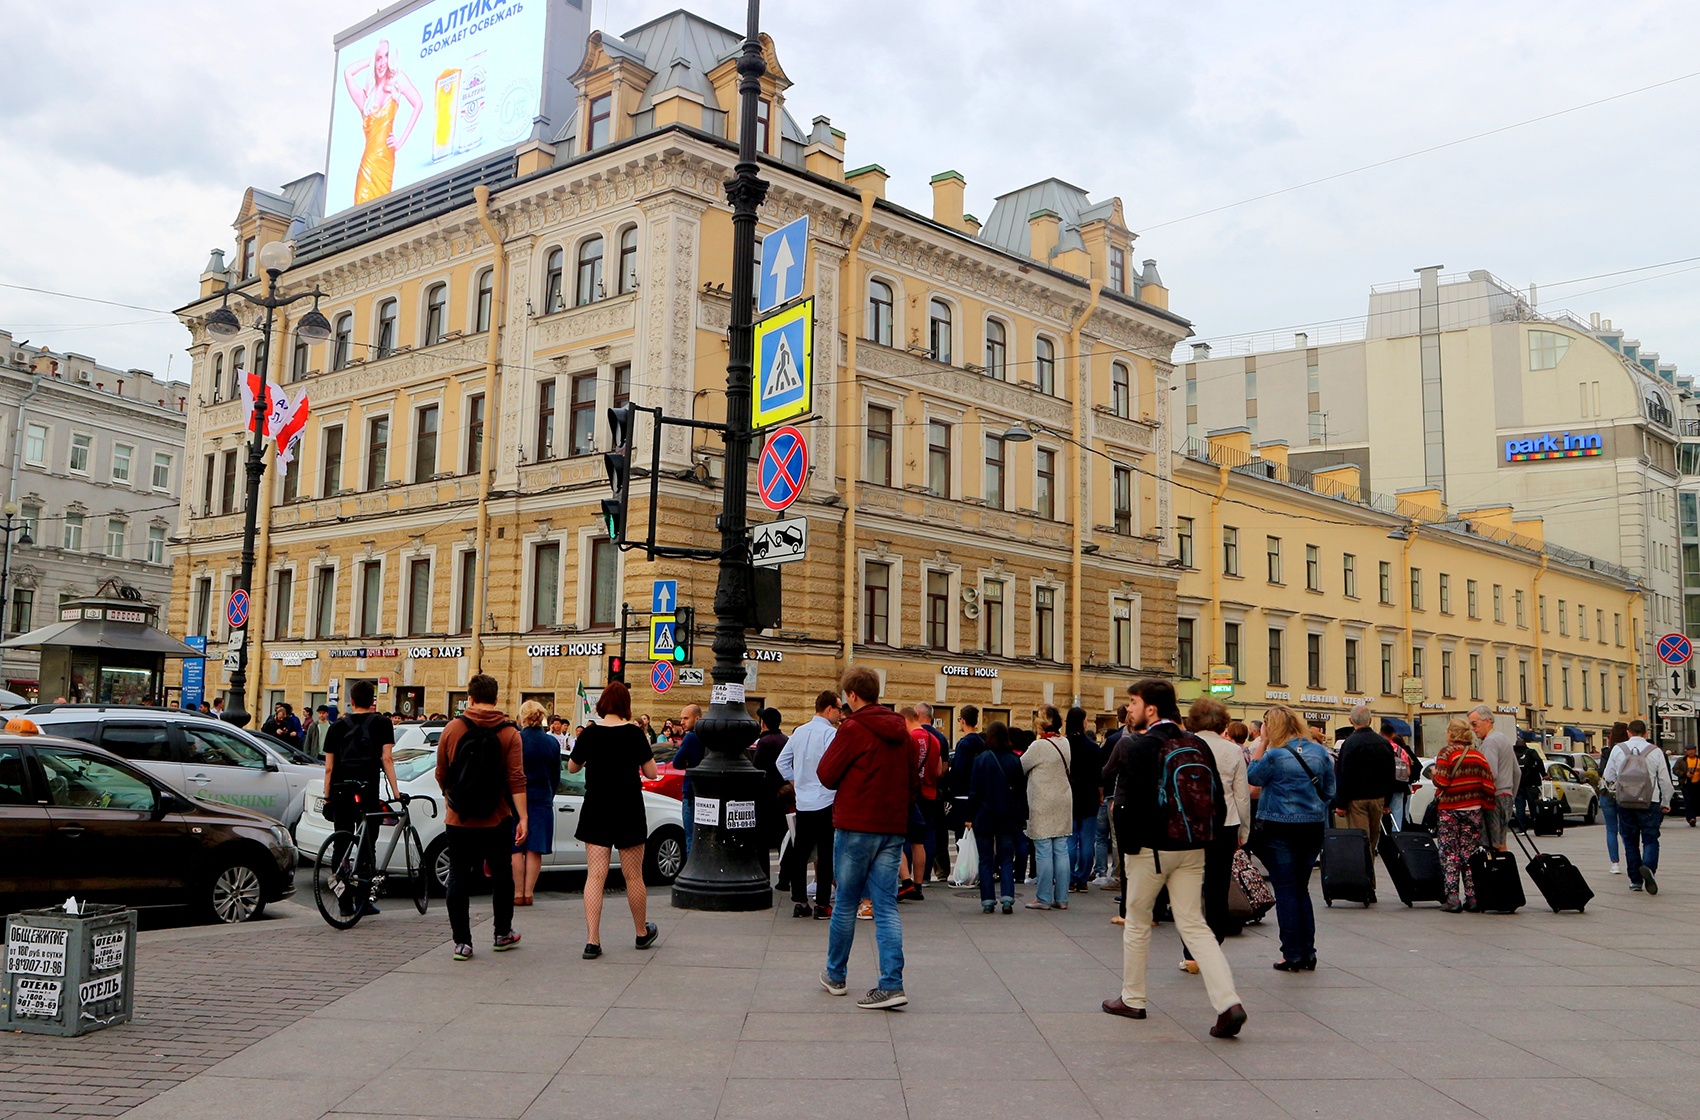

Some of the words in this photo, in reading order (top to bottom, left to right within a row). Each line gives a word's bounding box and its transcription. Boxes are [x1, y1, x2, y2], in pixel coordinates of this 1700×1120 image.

[420, 27, 468, 59] ОБОЖАЕТ
[469, 2, 524, 35] ОСВЕЖАТЬ
[1505, 433, 1559, 462] park
[1563, 431, 1602, 450] inn
[408, 647, 431, 658] КОФЕ
[438, 647, 463, 658] ХАУЗ
[527, 645, 560, 657] COFFEE
[569, 643, 603, 655] HOUSE
[756, 650, 783, 662] ХАУЗ
[943, 665, 969, 675] COFFEE
[974, 667, 999, 678] HOUSE
[1266, 691, 1291, 700] HOTEL
[197, 788, 277, 808] SUNSHINE
[11, 927, 66, 945] ОБЩЕЖИТИЕ
[96, 935, 123, 946] ОТЕЛЬ
[20, 980, 57, 990] ОТЕЛЬ
[81, 977, 119, 1002] ОТЕЛЬ
[17, 998, 57, 1009] 981-09-69
